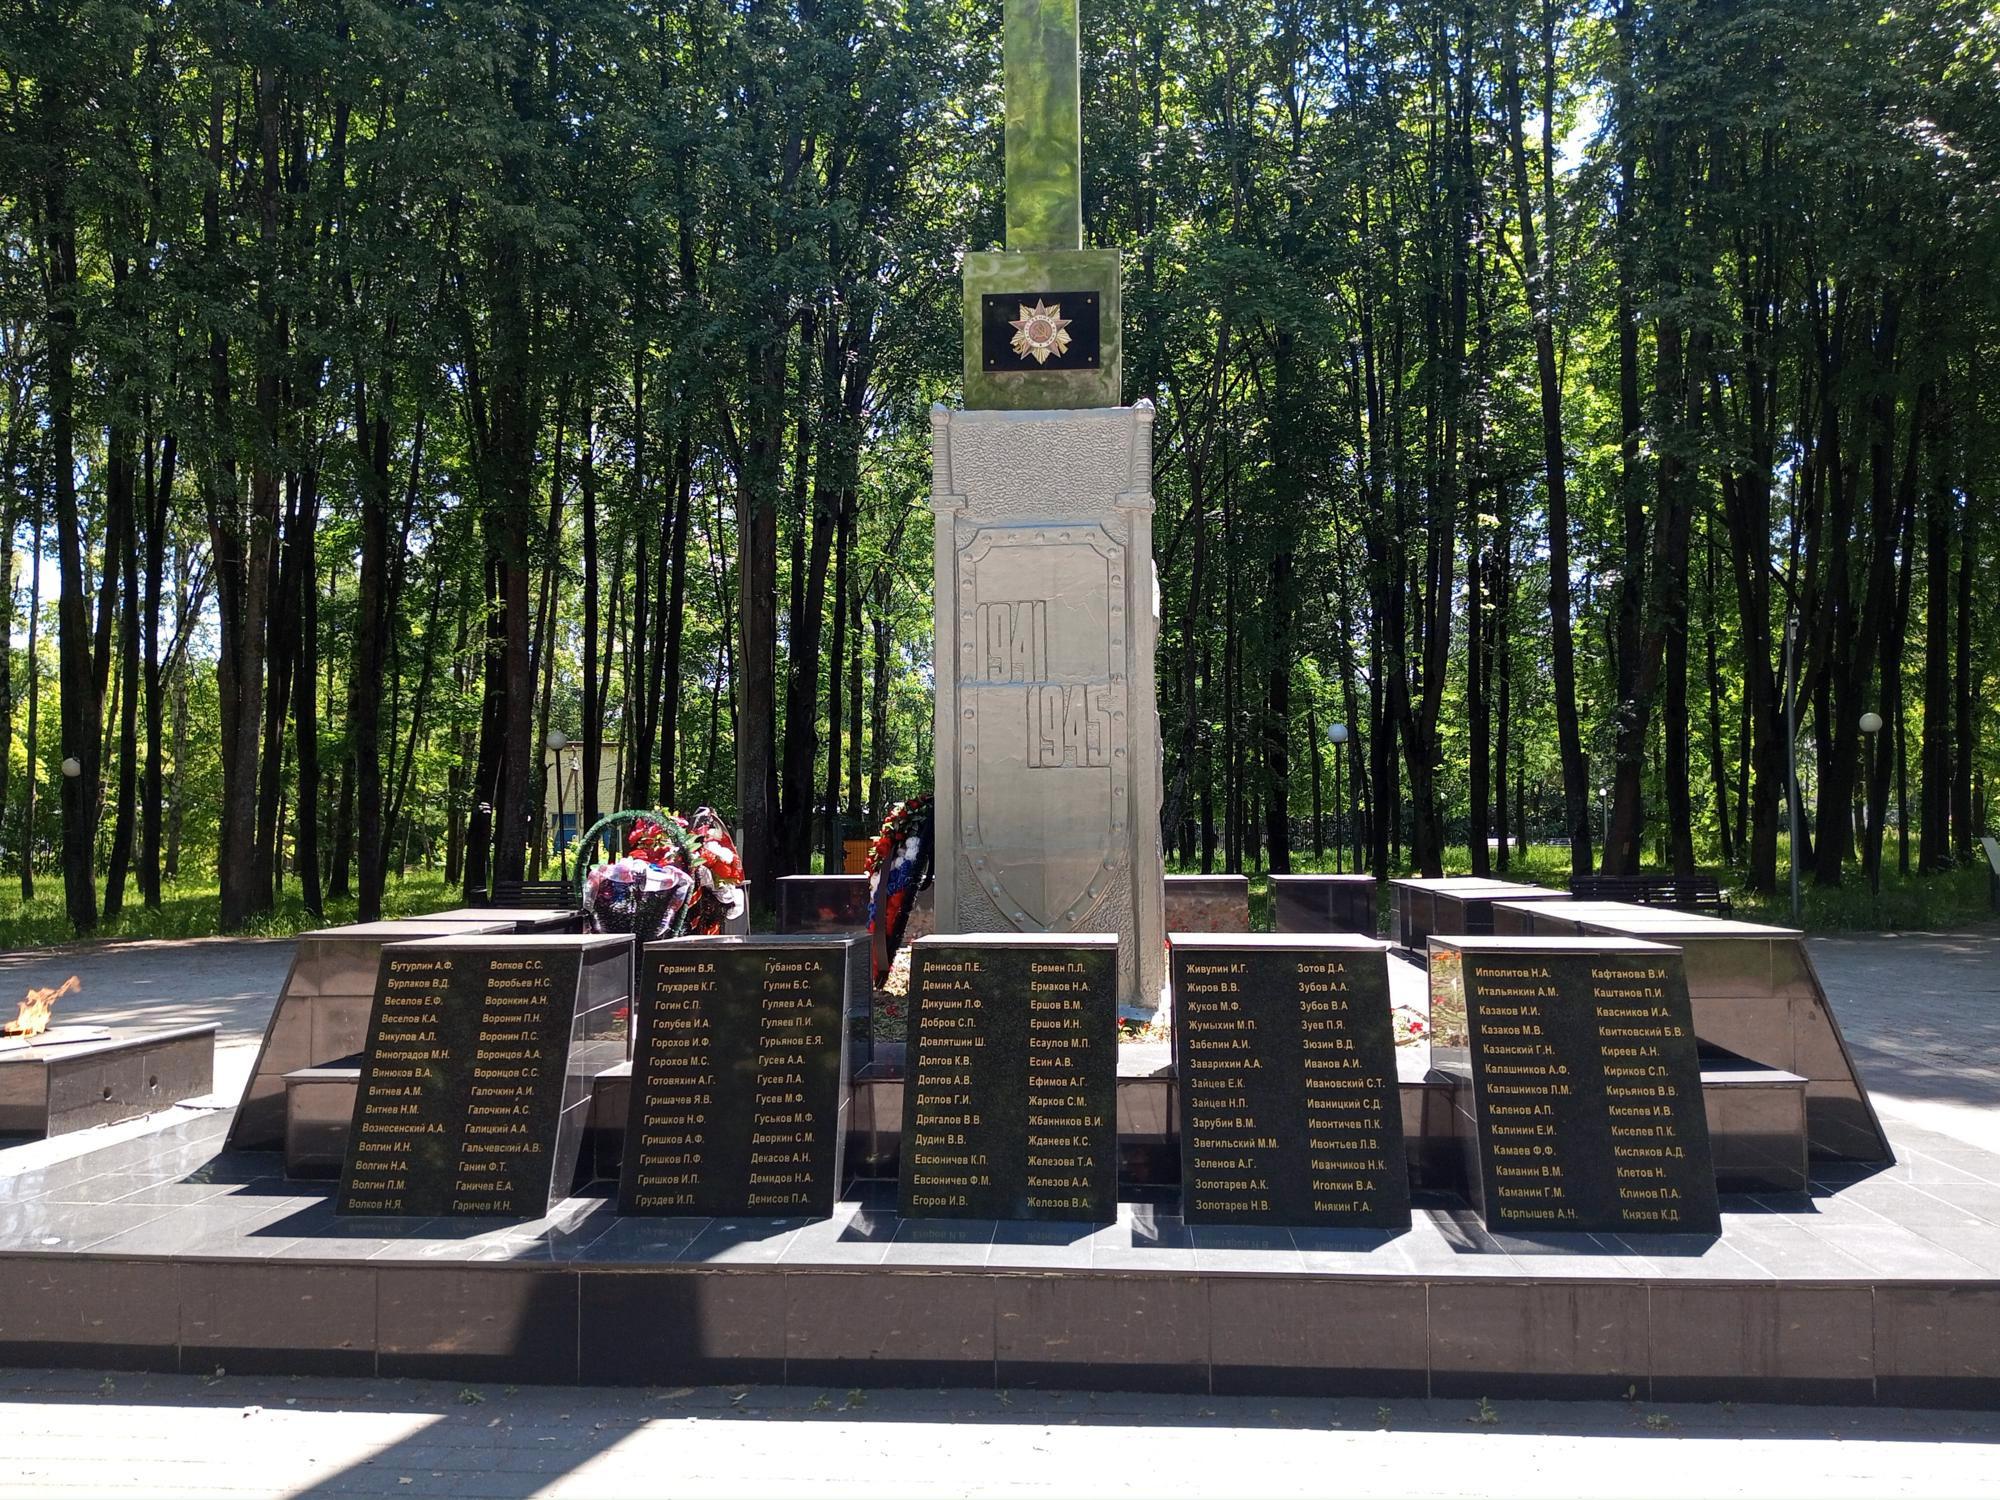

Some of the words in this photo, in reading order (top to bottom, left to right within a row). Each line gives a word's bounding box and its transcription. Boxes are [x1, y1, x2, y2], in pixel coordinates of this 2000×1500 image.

[975, 600, 1048, 682] 1941
[1026, 684, 1111, 769] 1945
[390, 961, 434, 973] Бутурлин
[434, 961, 455, 970] А.Ф.
[489, 960, 524, 970] Волков
[524, 960, 544, 970] С.С.
[658, 964, 697, 975] Геранин
[697, 963, 717, 973] В.Я.
[764, 961, 803, 974] Губанов
[804, 961, 823, 971] С.А.
[1186, 963, 1229, 976] Живулин
[1230, 963, 1250, 974] И.Г.
[1530, 967, 1553, 978] Н.А.
[1647, 968, 1669, 979] В.И.
[387, 978, 431, 990] Бурлаков
[656, 982, 700, 994] Глухарев
[700, 981, 718, 991] К.Г.
[763, 980, 792, 992] Гулин
[792, 979, 812, 990] Б.С.
[922, 979, 953, 992] Демин
[953, 980, 973, 990] А.А.
[1030, 981, 1070, 993] Ермаков
[1072, 981, 1091, 992] Н.А.
[1186, 982, 1219, 994] Жиров
[1220, 982, 1241, 992] В.В.
[1298, 981, 1328, 994] Зубов
[1329, 982, 1350, 992] А.А.
[1537, 986, 1560, 997] А.М.
[384, 996, 423, 1006] Веселов
[424, 996, 444, 1006] Е.Ф.
[654, 1000, 682, 1010] Гогин
[762, 998, 795, 1011] Гуляев
[796, 998, 815, 1008] А.А.
[921, 998, 963, 1011] Дикушин
[1030, 999, 1062, 1011] Ершов
[1063, 1000, 1084, 1010] В.М.
[1187, 1001, 1219, 1013] Жуков
[1219, 1001, 1242, 1011] М.Ф.
[1479, 1005, 1519, 1016] Казаков
[1520, 1005, 1541, 1016] И.И.
[1650, 1007, 1672, 1017] И.А.
[381, 1013, 420, 1024] Веселов
[421, 1013, 439, 1023] К.А.
[482, 1013, 522, 1025] Воронин
[920, 1017, 956, 1029] Добров
[1030, 1018, 1062, 1030] Ершов
[1063, 1018, 1083, 1029] И.Н.
[1188, 1020, 1235, 1032] Жумыхин
[1301, 1019, 1325, 1032] Зуев
[1481, 1024, 1521, 1035] Казаков
[1522, 1024, 1545, 1036] М.В.
[1663, 1026, 1685, 1037] Б.В.
[378, 1031, 417, 1043] Викулов
[479, 1031, 520, 1043] Воронин
[651, 1037, 690, 1049] Горохов
[692, 1037, 712, 1047] И.Ф.
[759, 1036, 804, 1048] Гурьянов
[805, 1035, 825, 1045] Е.Я.
[1189, 1039, 1230, 1049] Забелин
[1231, 1039, 1251, 1049] А.И.
[1302, 1039, 1334, 1049] Зюзин
[1535, 1044, 1556, 1055] Г.Н.
[430, 1049, 451, 1059] М.Н.
[476, 1049, 523, 1060] Воронцов
[523, 1049, 543, 1059] А.А.
[649, 1056, 689, 1069] Горохов
[690, 1055, 711, 1066] М.С.
[758, 1055, 785, 1067] Гусев
[786, 1054, 806, 1065] А.А.
[918, 1055, 953, 1067] Долгов
[954, 1055, 973, 1066] К.В.
[1029, 1056, 1053, 1067] Есин
[1054, 1057, 1075, 1067] А.В.
[1243, 1058, 1264, 1069] А.А.
[1304, 1058, 1341, 1069] Иванов
[1342, 1058, 1363, 1069] А.И.
[473, 1067, 520, 1079] Воронцов
[521, 1067, 541, 1078] С.С.
[1548, 1064, 1571, 1075] А.Ф.
[1603, 1065, 1647, 1078] Кириков
[697, 1074, 717, 1085] А.Г.
[917, 1074, 952, 1086] Долгов
[953, 1074, 973, 1085] А.В.
[1366, 1078, 1386, 1088] С.Т.
[1605, 1085, 1656, 1098] Кирьянов
[1657, 1085, 1679, 1097] В.В.
[755, 1093, 783, 1105] Гусев
[784, 1093, 806, 1103] М.Ф.
[1028, 1095, 1065, 1108] Жарков
[1066, 1096, 1088, 1107] С.М.
[1084, 1116, 1104, 1127] В.И.
[1192, 1117, 1234, 1130] Зарубин
[1235, 1117, 1257, 1128] В.М.
[1491, 1124, 1535, 1135] Калинин
[1536, 1124, 1558, 1136] Е.И.
[751, 1132, 793, 1145] Дворкин
[795, 1132, 815, 1143] С.М.
[914, 1133, 946, 1147] Дудин
[947, 1134, 967, 1145] В.В.
[1027, 1135, 1071, 1147] Жданеев
[1072, 1135, 1092, 1147] К.С.
[358, 1141, 392, 1152] Волгин
[393, 1141, 413, 1152] И.Н.
[1493, 1144, 1531, 1156] Камаев
[1532, 1145, 1557, 1156] Ф.Ф.
[1194, 1158, 1236, 1169] Зеленов
[1237, 1158, 1257, 1169] А.Г.
[1367, 1159, 1388, 1170] Н.К.
[1495, 1165, 1540, 1177] Каманин
[1541, 1165, 1565, 1177] В.М.
[1616, 1166, 1654, 1178] Клетов
[1655, 1167, 1667, 1178] Н.
